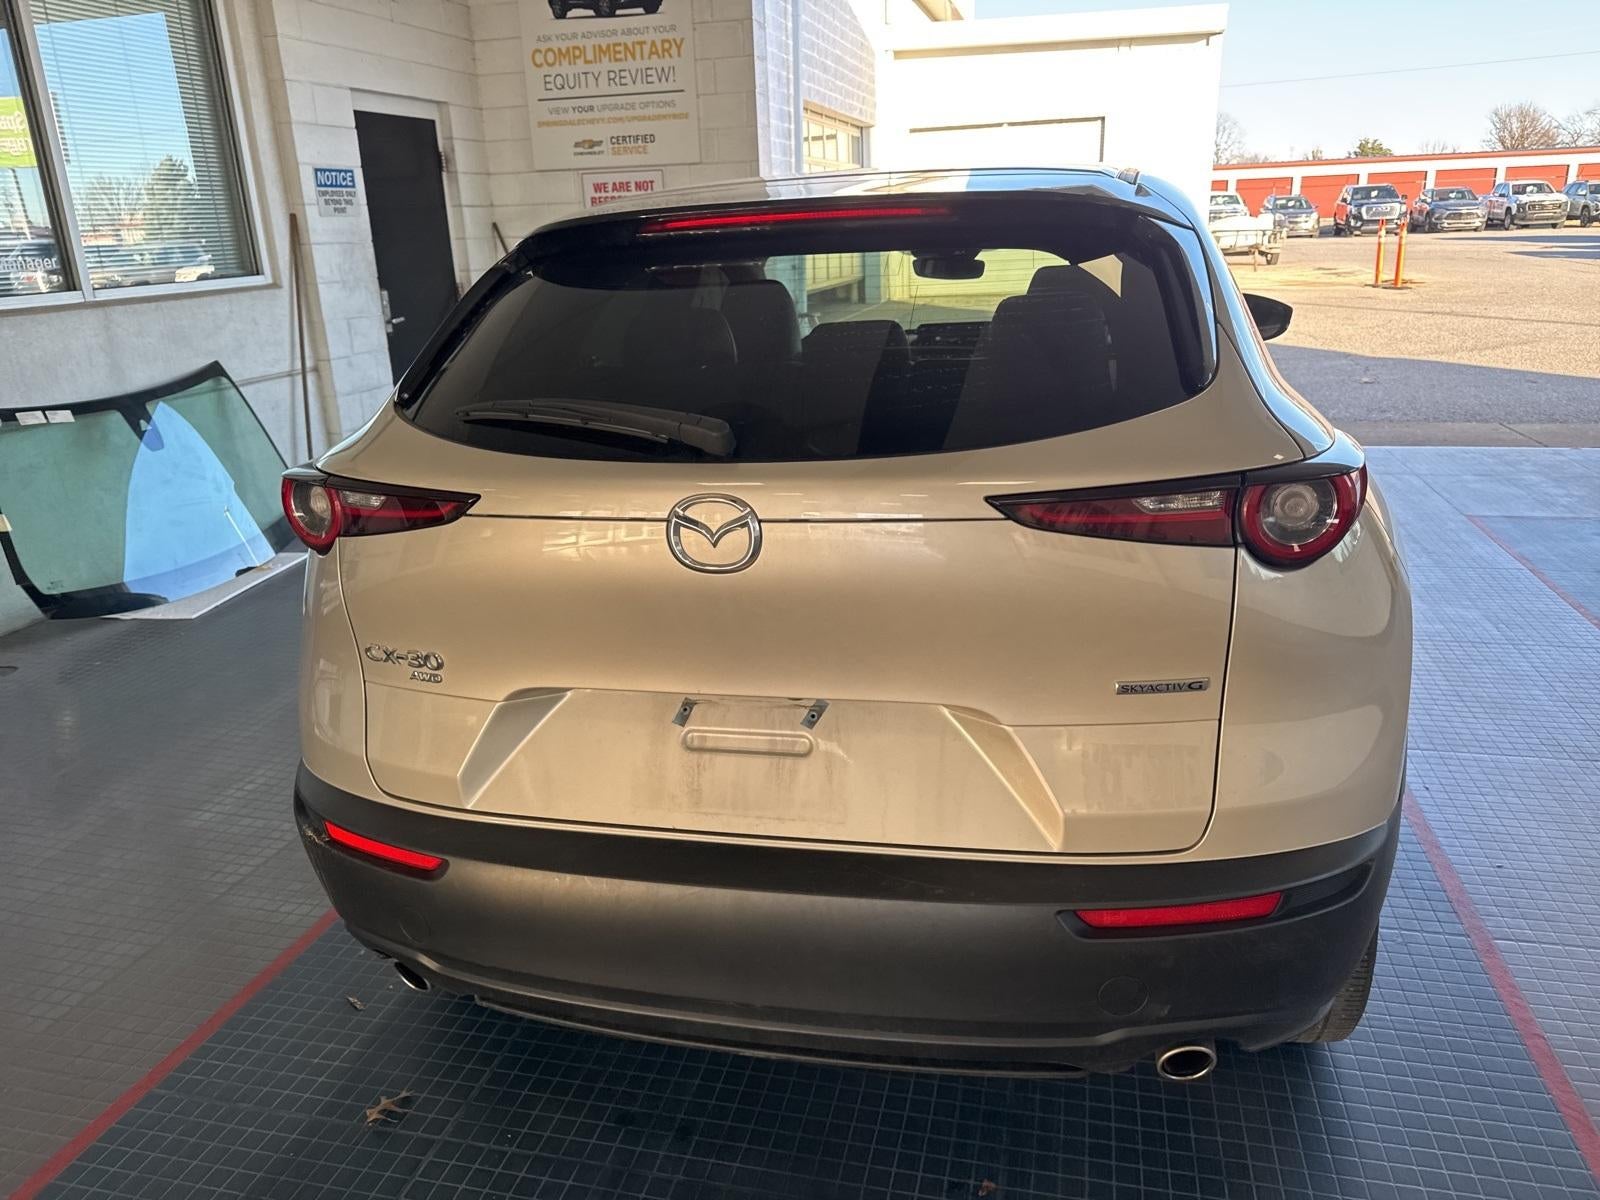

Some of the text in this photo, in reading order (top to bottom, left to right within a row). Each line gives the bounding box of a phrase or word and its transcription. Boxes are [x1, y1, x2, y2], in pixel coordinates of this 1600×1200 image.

[536, 24, 677, 43] ASK YOUR ADVISOR ABOUT YOUR
[531, 37, 685, 68] COMPLIMENTARY
[543, 66, 676, 92] EQUITY REVIEW!
[546, 100, 676, 115] VIEW YOUR UPGRADE OPTIONS
[610, 134, 655, 146] CERTIFIED
[611, 145, 648, 155] SERVICE
[316, 171, 354, 186] NOTICE
[592, 180, 655, 193] WE ARE NOT
[364, 645, 445, 671] CX-30
[409, 670, 443, 684] AWD
